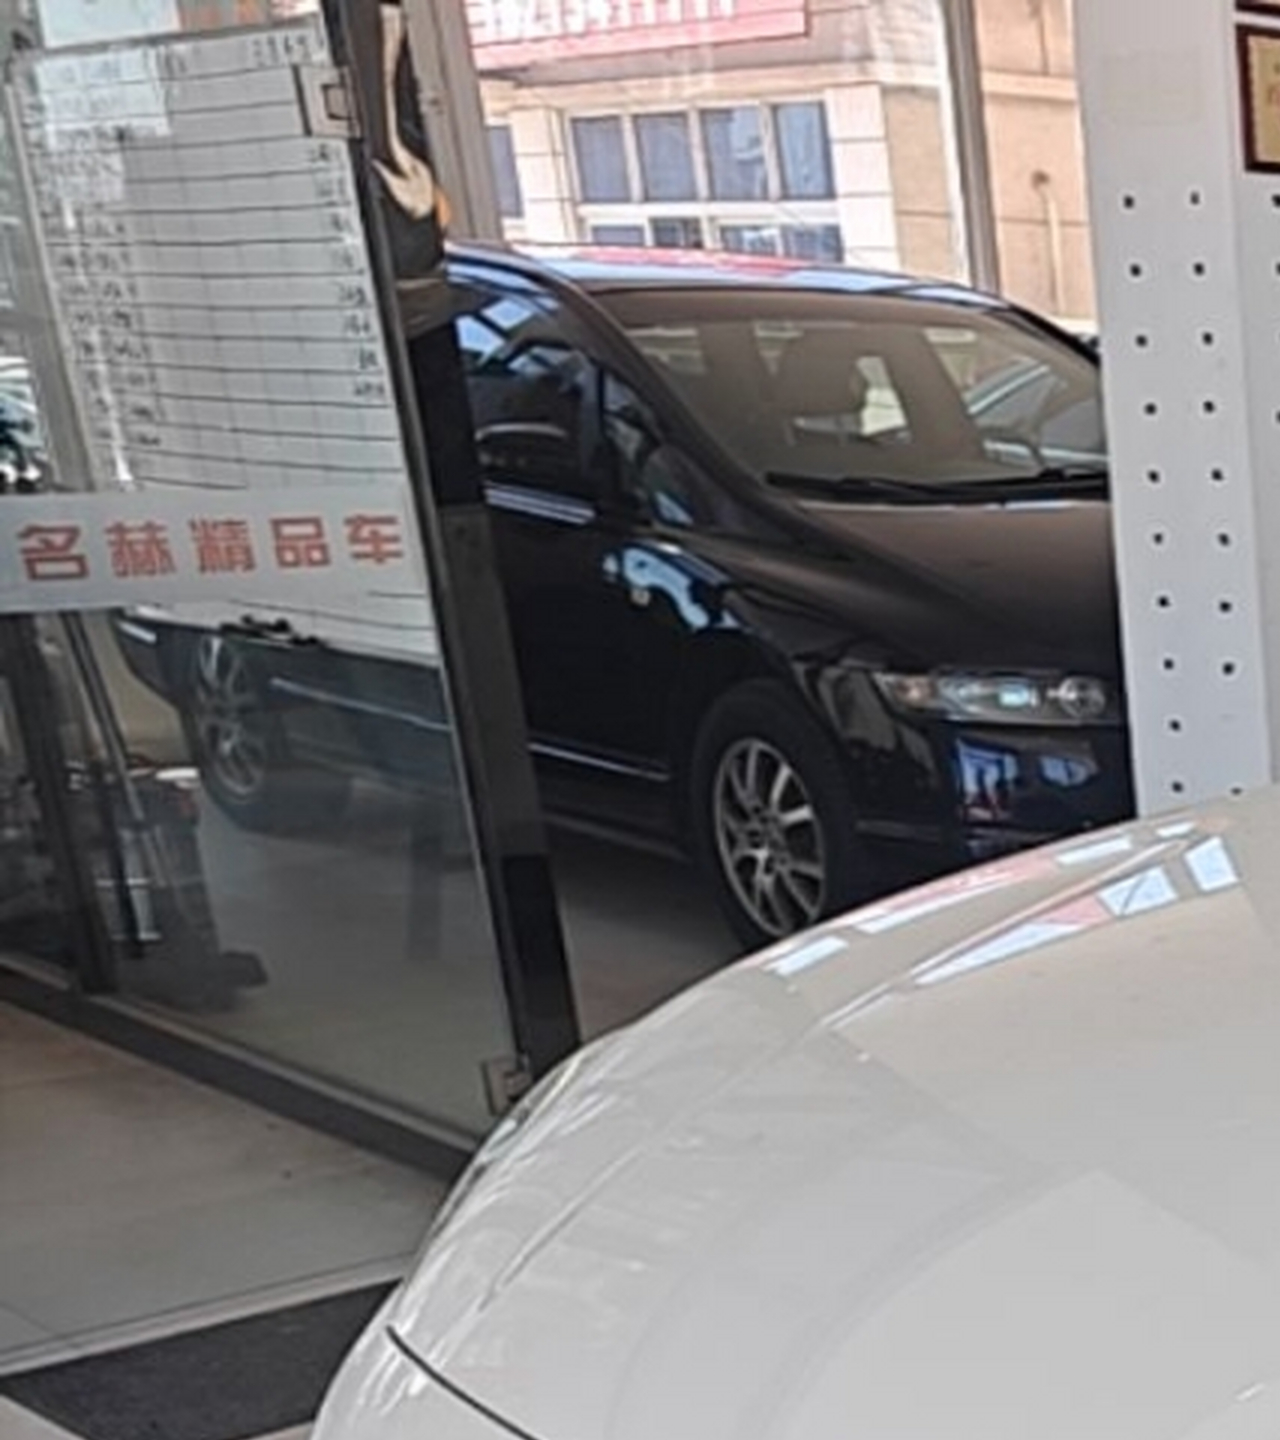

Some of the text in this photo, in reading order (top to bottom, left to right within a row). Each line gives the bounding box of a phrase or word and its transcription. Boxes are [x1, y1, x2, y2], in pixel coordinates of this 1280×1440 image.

[15, 513, 405, 583] 名赫精品车
